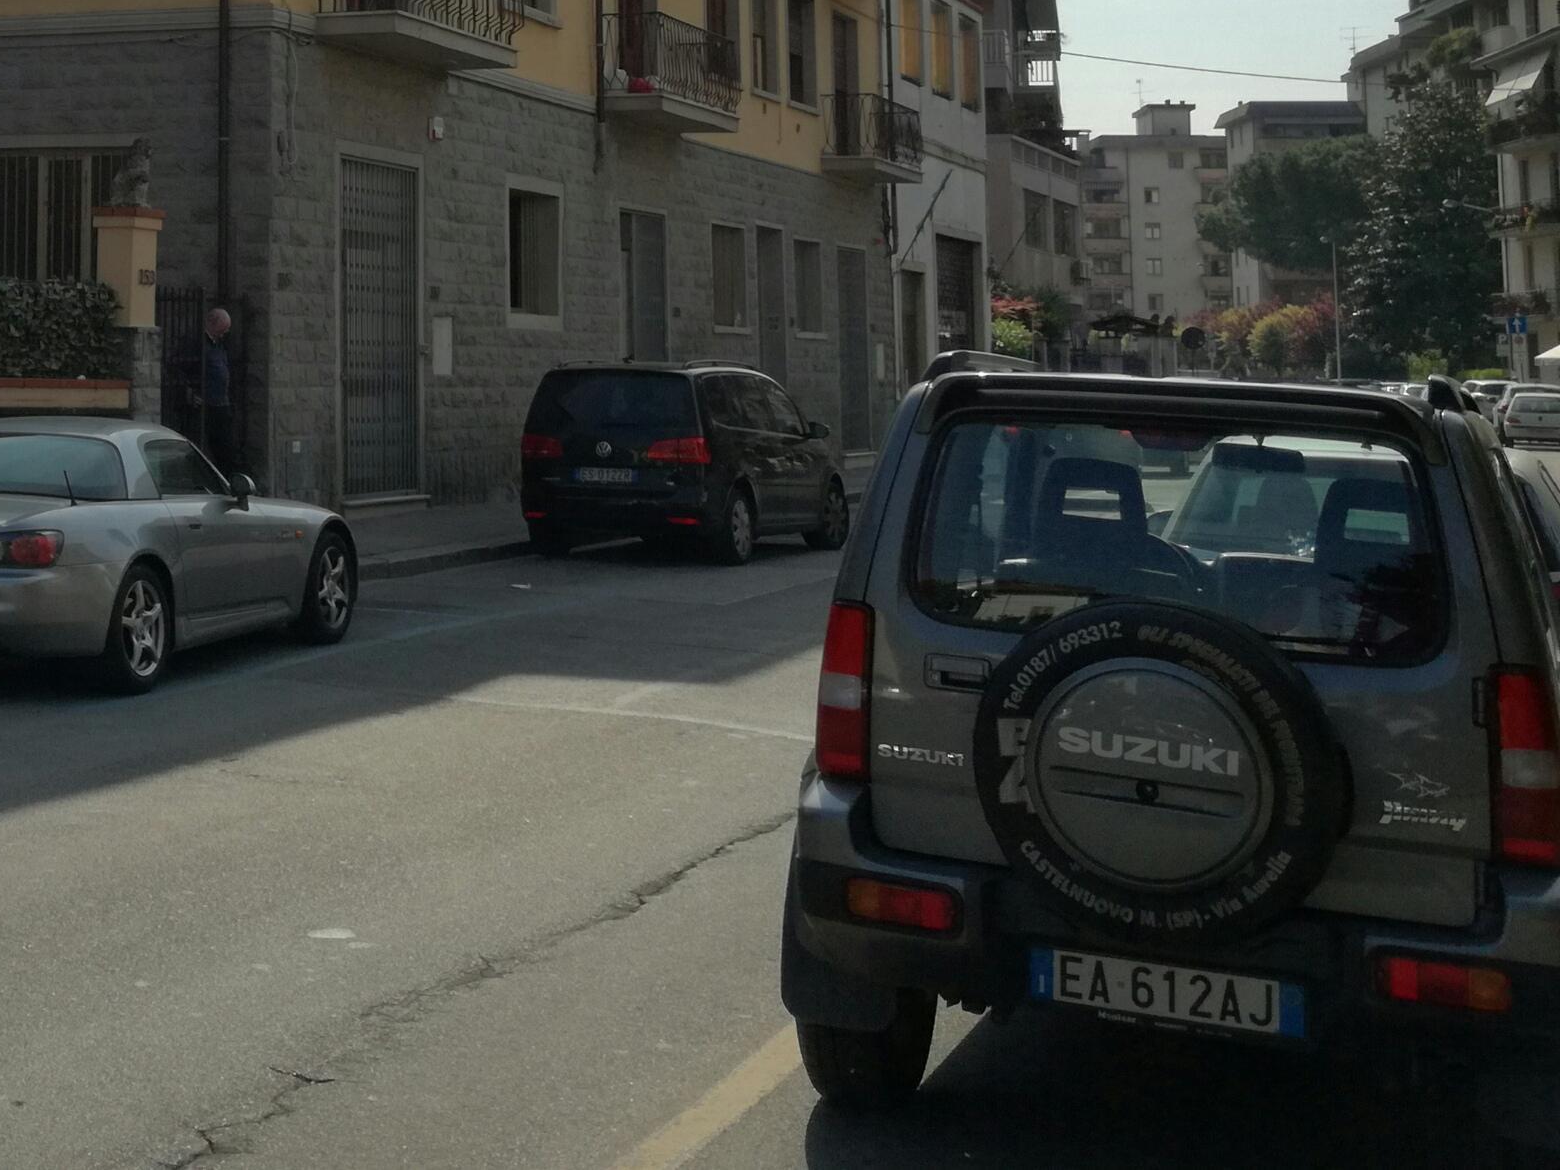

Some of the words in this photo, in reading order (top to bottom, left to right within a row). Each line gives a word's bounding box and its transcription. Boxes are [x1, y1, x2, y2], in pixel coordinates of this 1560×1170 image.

[1059, 620, 1123, 654] 693312
[877, 743, 964, 767] SUZUKI
[1057, 726, 1239, 776] SUZUKI
[1020, 839, 1134, 923] CASTELNUOVO
[1241, 849, 1293, 905] Aurelia
[1059, 954, 1110, 1005] EA
[1131, 966, 1273, 1027] 612AJ
